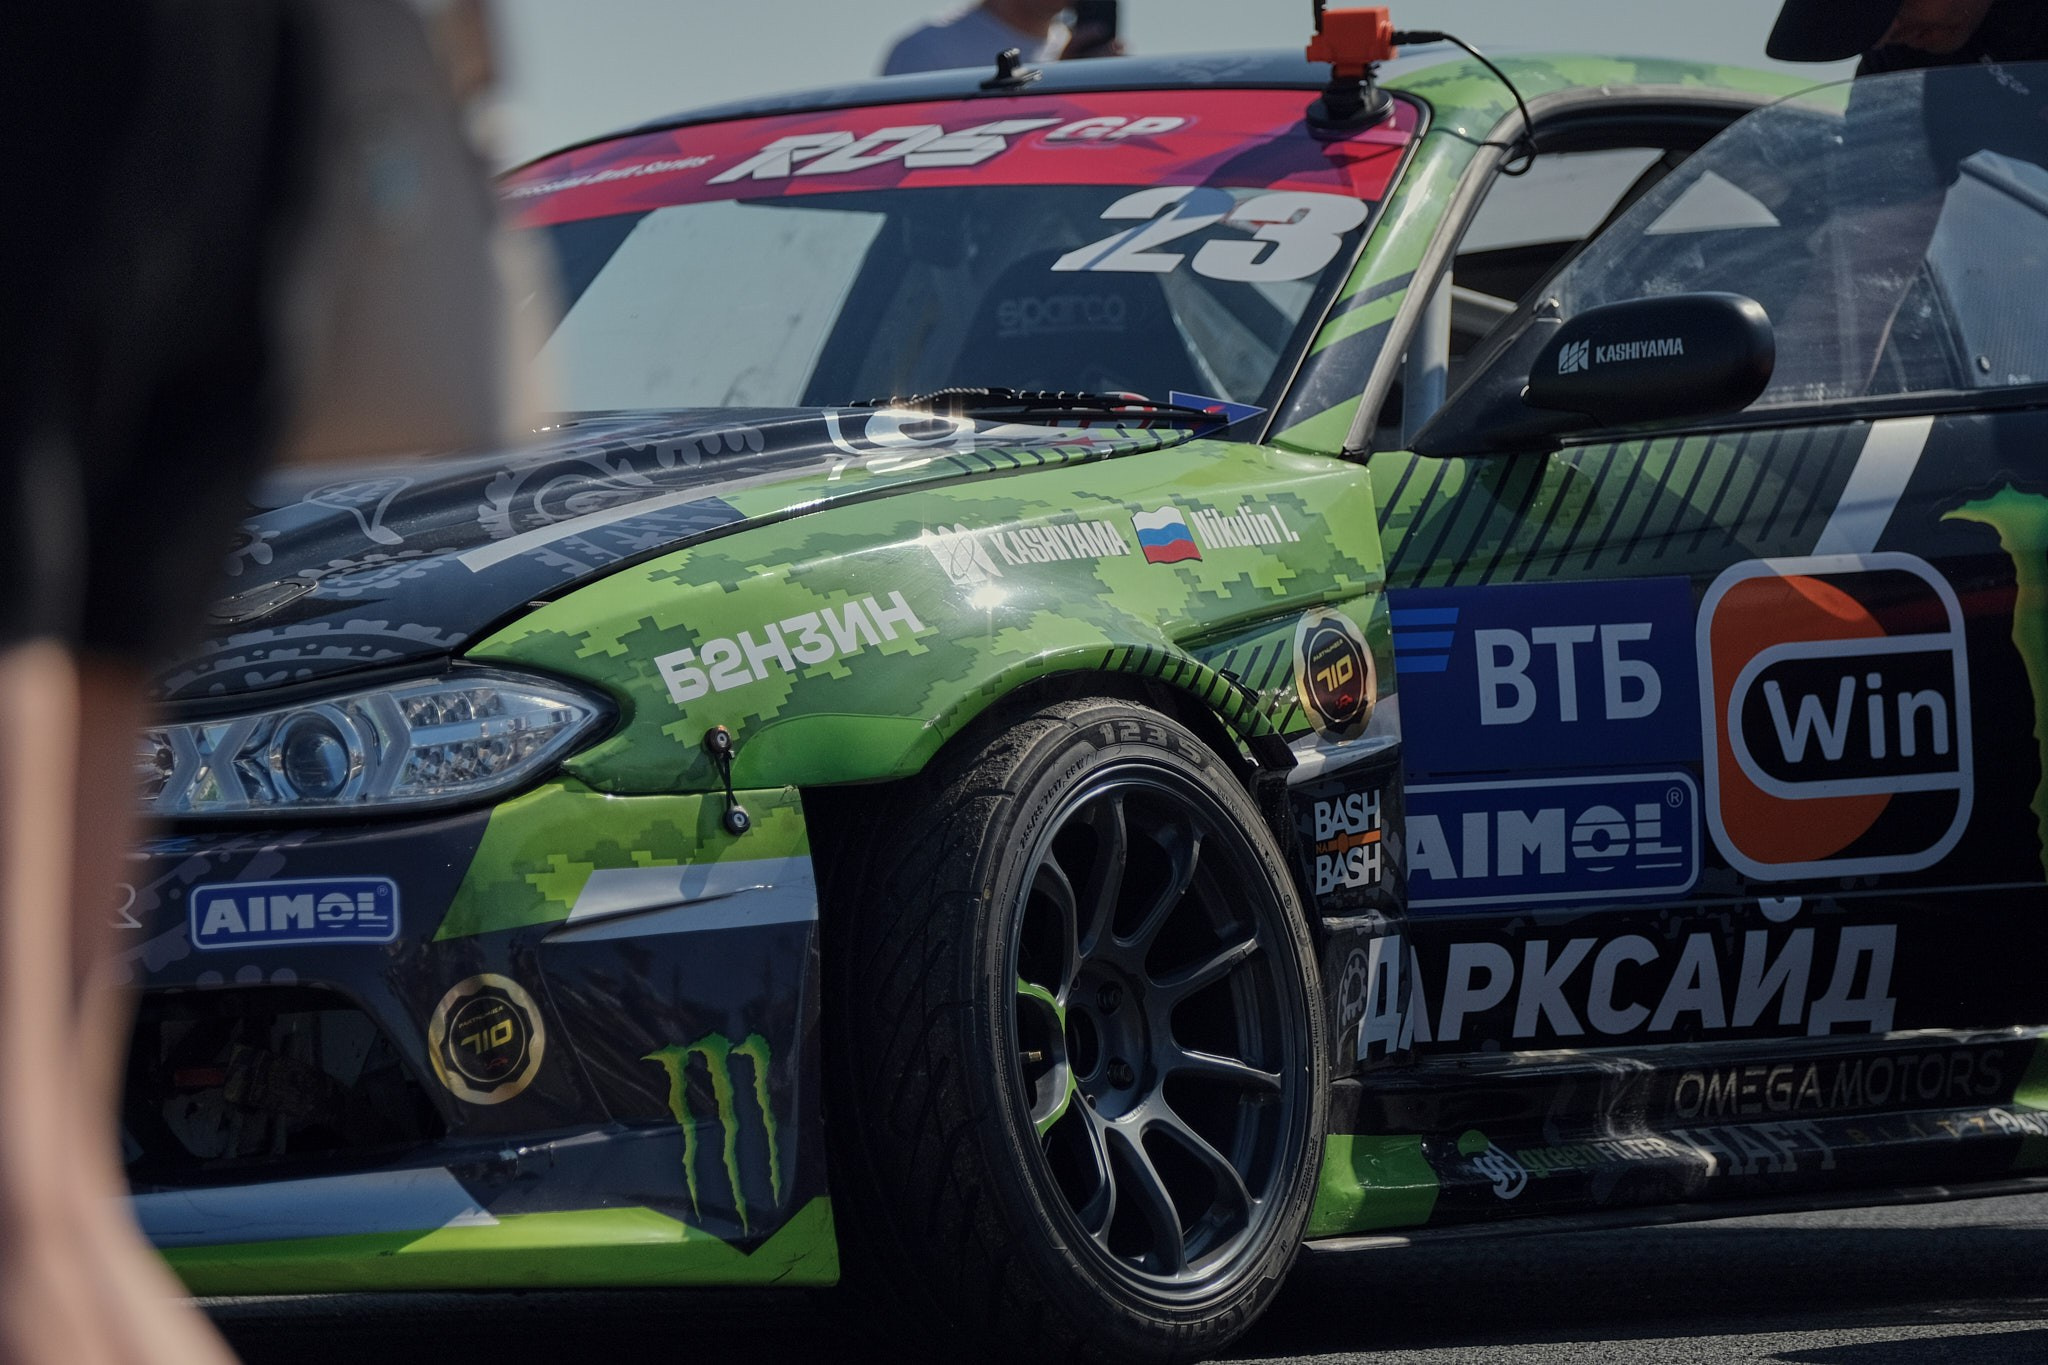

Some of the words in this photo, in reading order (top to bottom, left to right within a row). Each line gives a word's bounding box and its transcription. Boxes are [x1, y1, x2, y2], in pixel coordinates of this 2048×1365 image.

[706, 117, 1064, 185] RDS
[1045, 115, 1186, 143] GP
[1051, 186, 1369, 282] 23
[1595, 338, 1684, 364] KASHIYAMA
[989, 519, 1131, 566] KASHIYAMA
[1190, 505, 1282, 550] Nikulin
[1316, 654, 1354, 692] 710
[1474, 622, 1662, 726] ВТБ
[1763, 672, 1949, 763] Win
[1314, 789, 1381, 842] BASH
[1315, 842, 1381, 896] BASH
[1357, 897, 1898, 1062] ДАРКСАЙД
[460, 1019, 513, 1056] 710
[1675, 1061, 1826, 1119] OMEGA
[1830, 1048, 2004, 1108] MOTORS
[1672, 1120, 1837, 1178] HAFT
